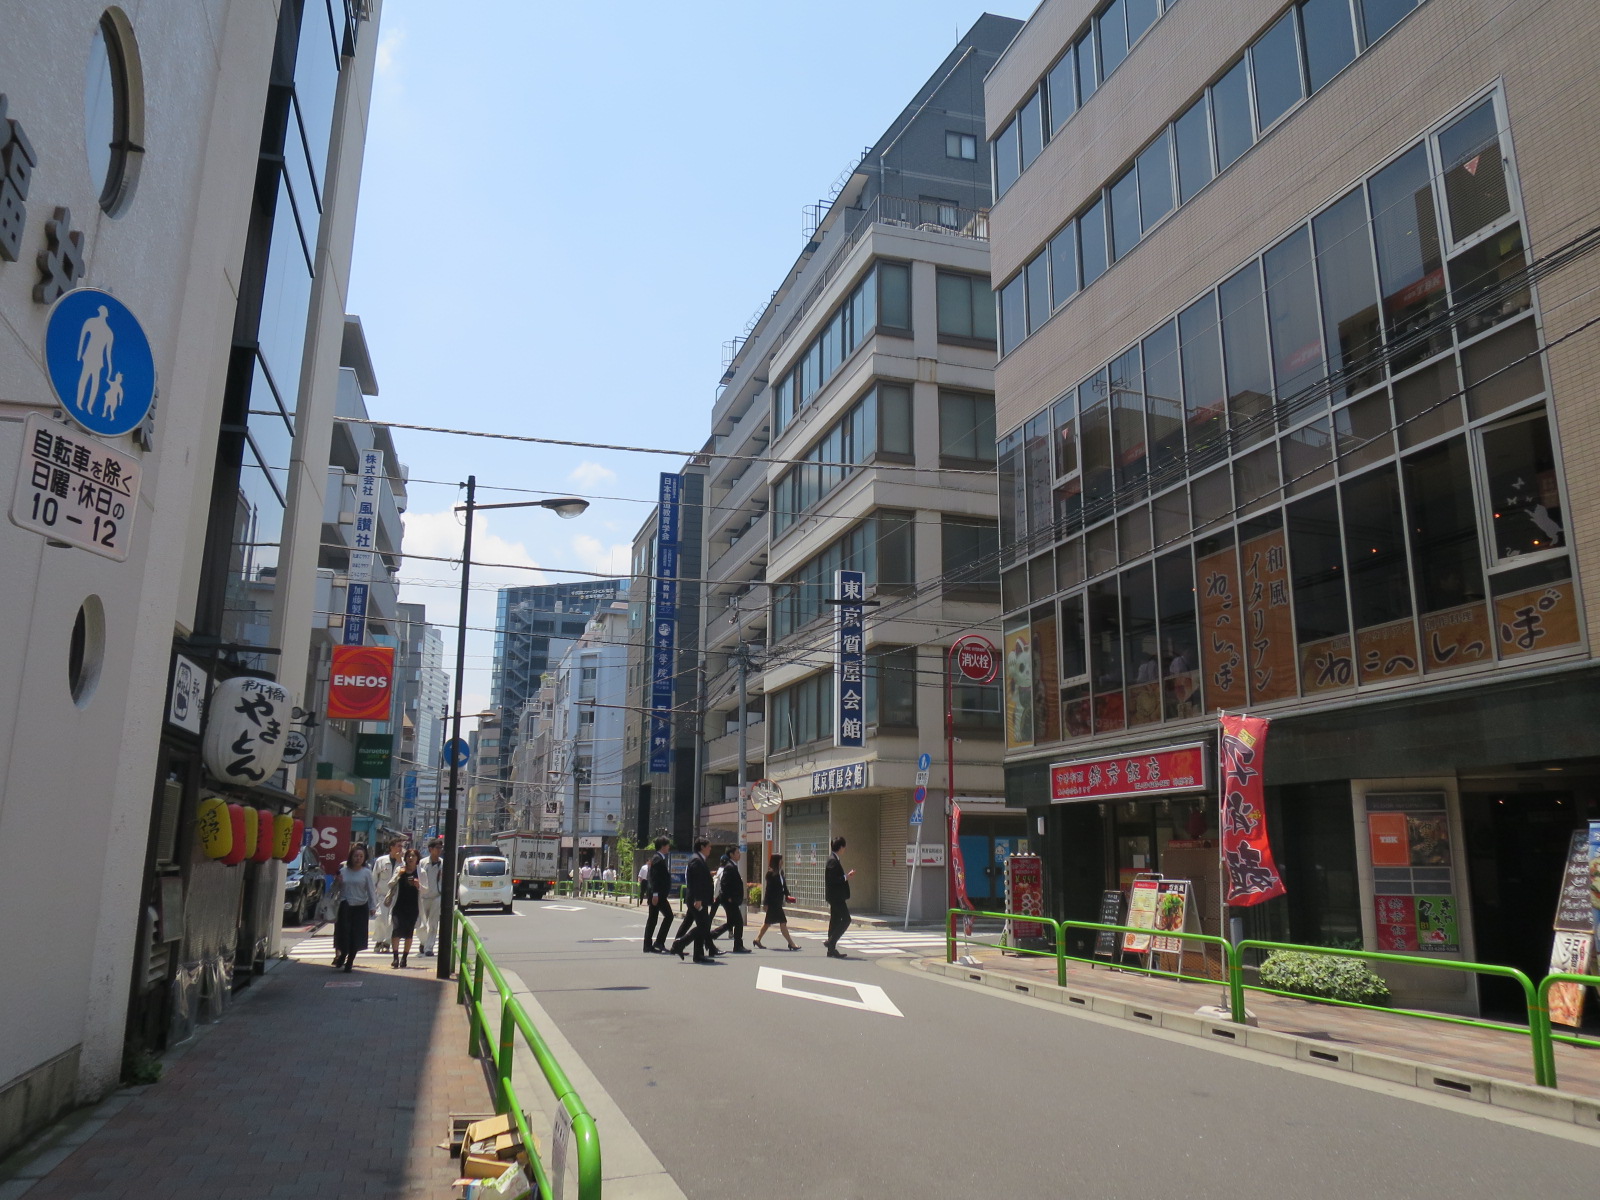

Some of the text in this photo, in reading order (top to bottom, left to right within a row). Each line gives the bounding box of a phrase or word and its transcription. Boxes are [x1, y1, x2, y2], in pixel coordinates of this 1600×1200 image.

[31, 460, 125, 520] 日曜・休日の
[33, 429, 133, 493] 自転車を除く
[362, 454, 377, 496] 株式会社
[1266, 546, 1288, 606] 和風
[1247, 552, 1273, 692] イタリアン
[333, 674, 388, 688] ENEOS
[841, 579, 863, 740] 東京質屋会館
[961, 652, 990, 669] 消火栓
[242, 680, 286, 702] 新橋
[225, 692, 281, 781] やきとん
[813, 764, 863, 793] 東京質屋会館
